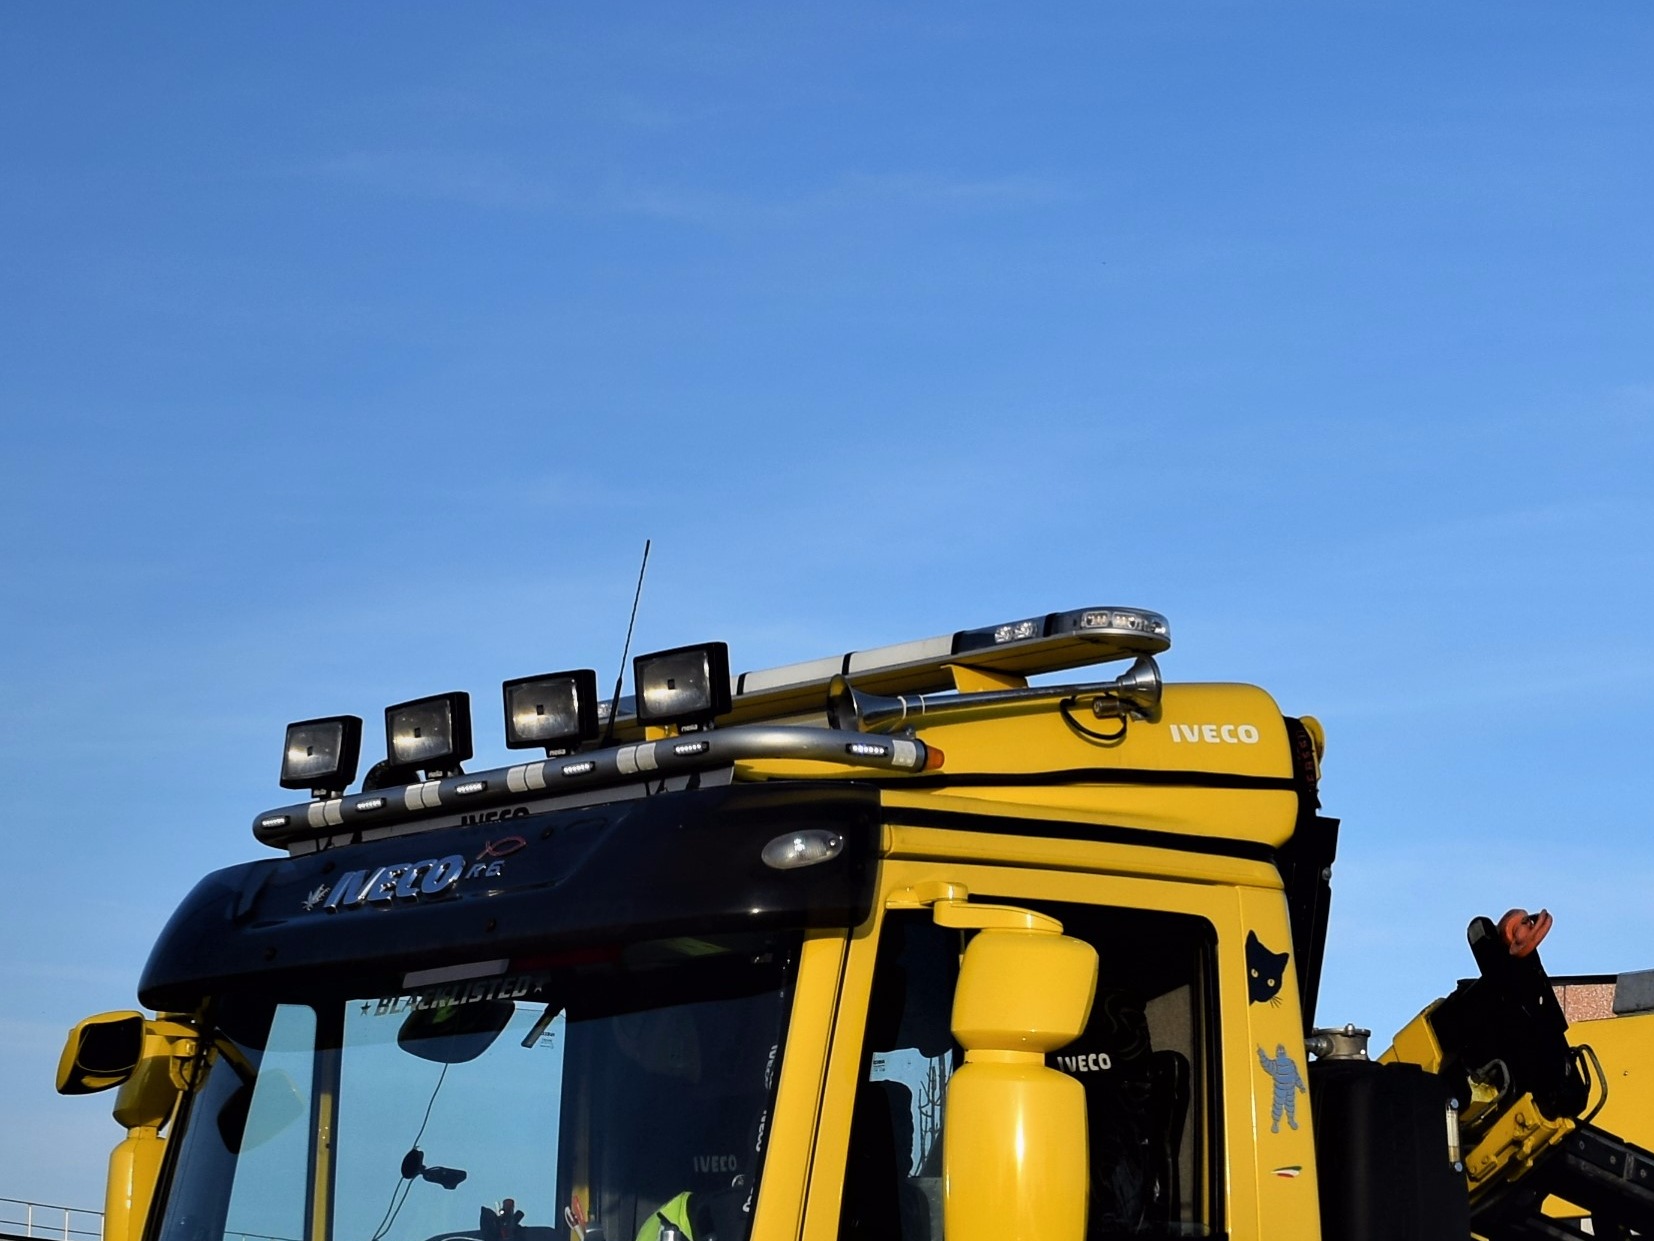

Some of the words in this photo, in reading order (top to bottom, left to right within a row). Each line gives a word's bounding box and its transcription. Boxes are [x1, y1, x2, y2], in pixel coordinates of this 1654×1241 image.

[1170, 724, 1260, 744] IVECO
[323, 854, 467, 914] IVECO
[373, 974, 530, 1017] BLACKLISTED
[1056, 1052, 1112, 1073] IVECO
[693, 1154, 737, 1173] IVECO
